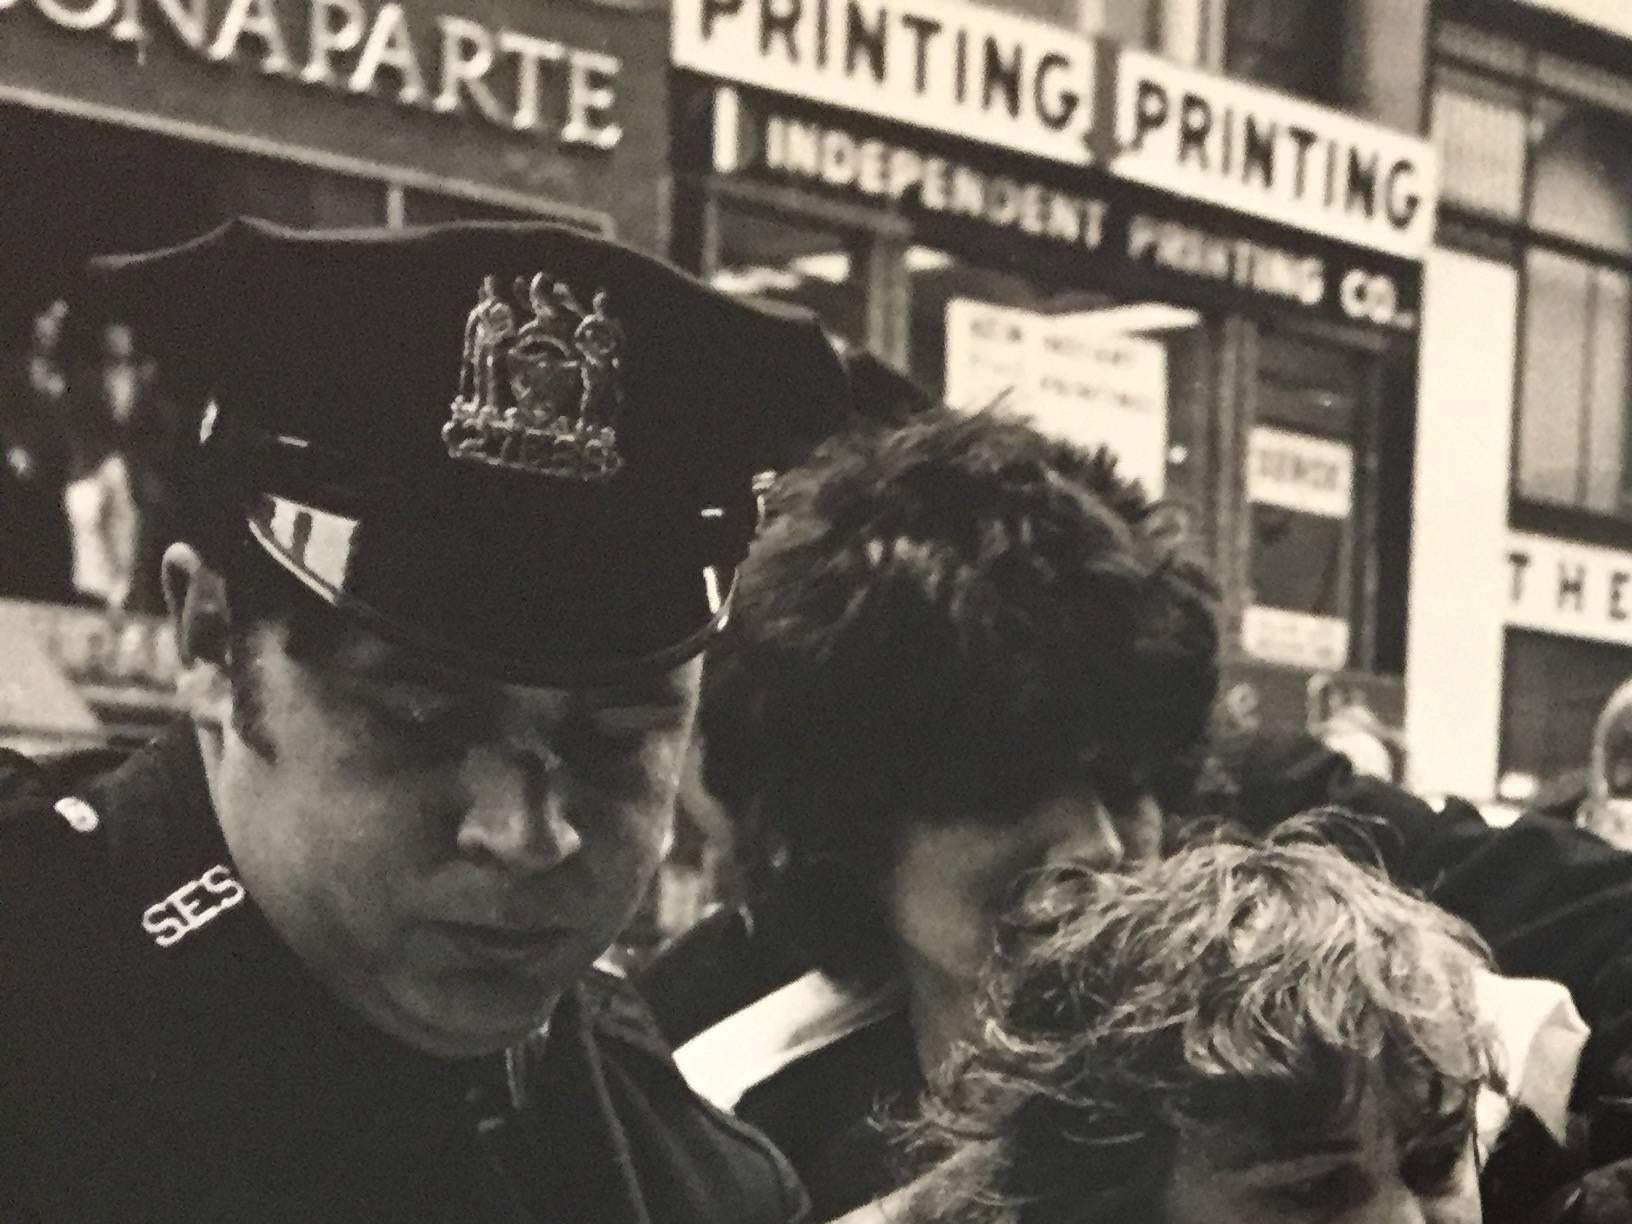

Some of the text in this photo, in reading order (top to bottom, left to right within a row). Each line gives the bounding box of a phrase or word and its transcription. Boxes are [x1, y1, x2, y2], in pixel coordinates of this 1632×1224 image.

[700, 0, 1081, 131] PRINTING
[766, 116, 1108, 251] INDEPENDENT
[1127, 214, 1326, 306] PRINTING
[1129, 78, 1420, 231] PRINTING
[1508, 553, 1630, 620] THE
[142, 864, 246, 947] SES
